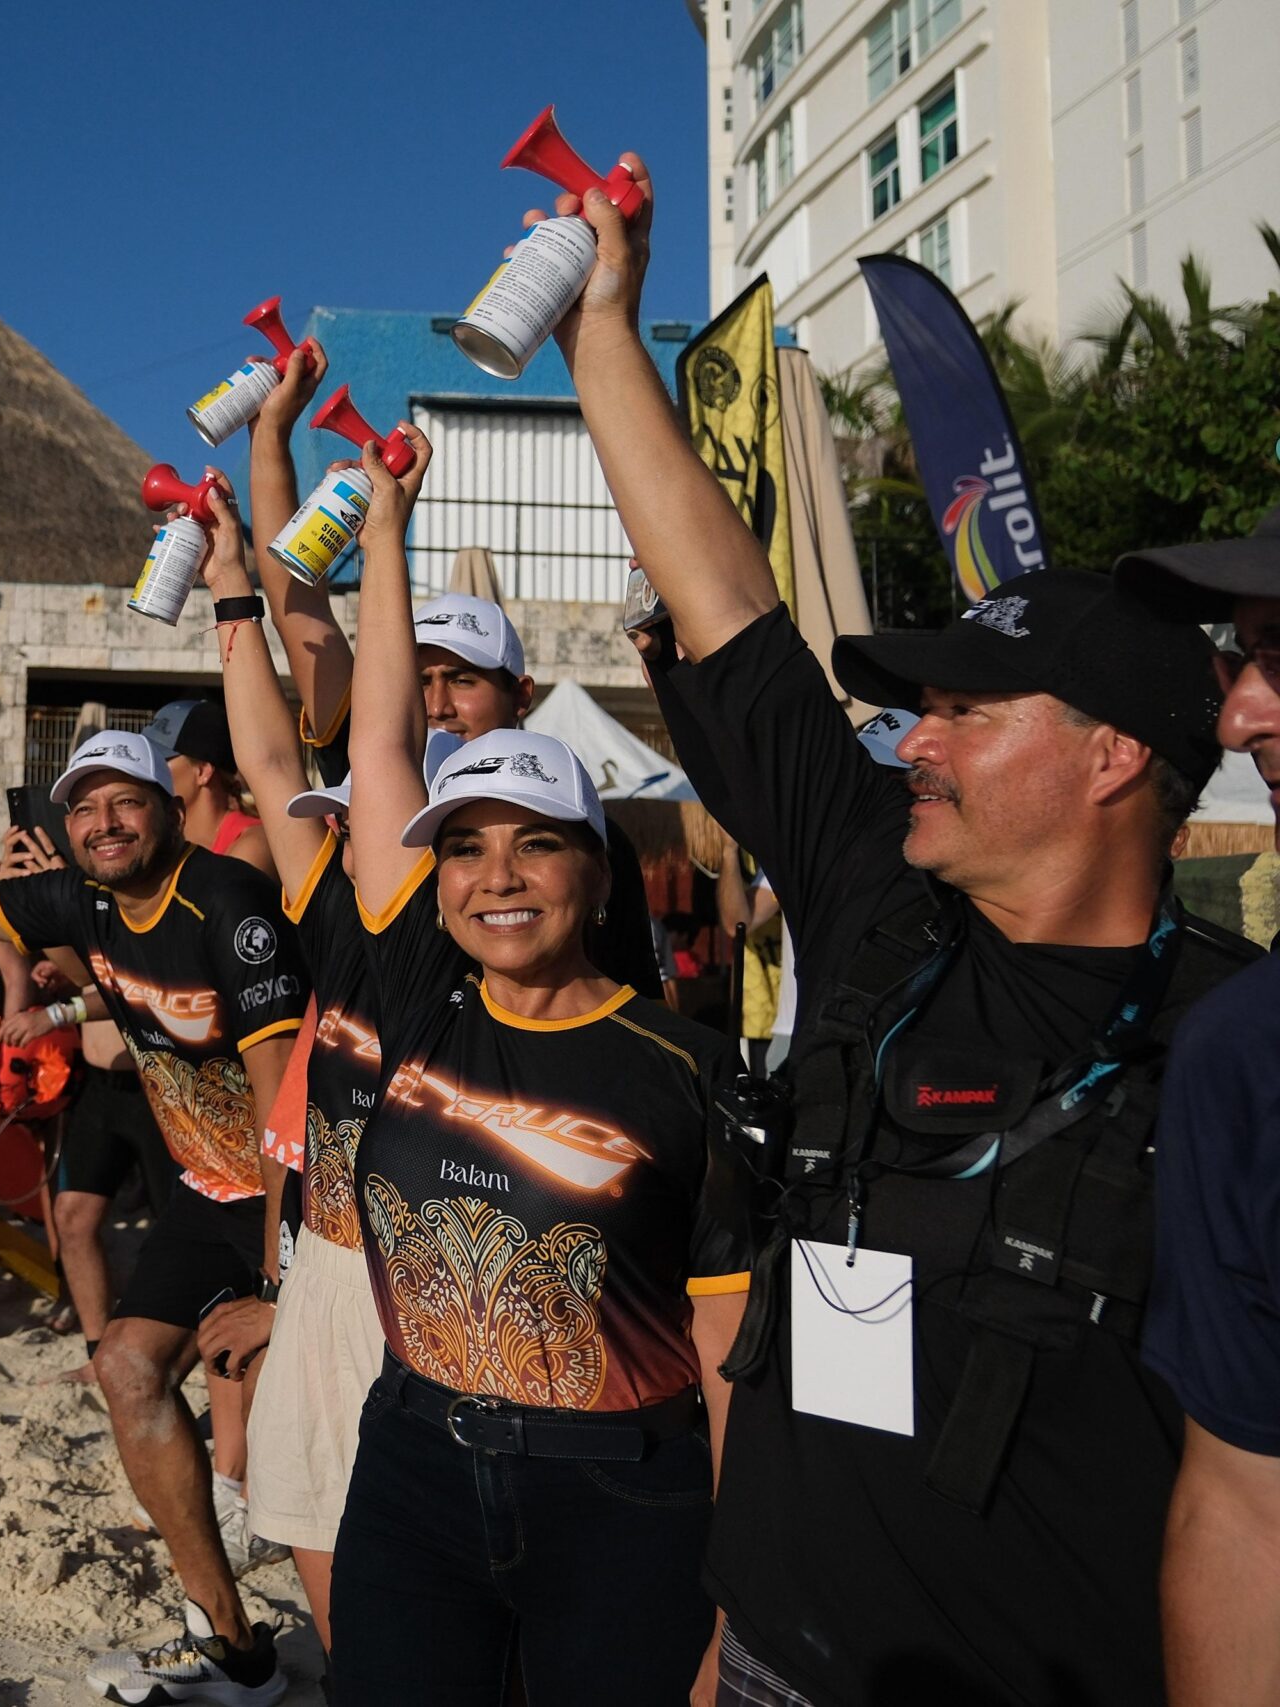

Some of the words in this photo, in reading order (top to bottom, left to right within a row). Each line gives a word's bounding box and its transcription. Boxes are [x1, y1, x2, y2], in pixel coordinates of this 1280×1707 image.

[980, 441, 1047, 574] rolit
[122, 983, 218, 1014] CRUCE
[352, 1088, 376, 1109] Bal
[443, 1094, 654, 1161] CRUCE
[791, 1147, 832, 1161] KAMPAK
[440, 1159, 511, 1193] Balam
[1003, 1235, 1056, 1261] KAMPAK
